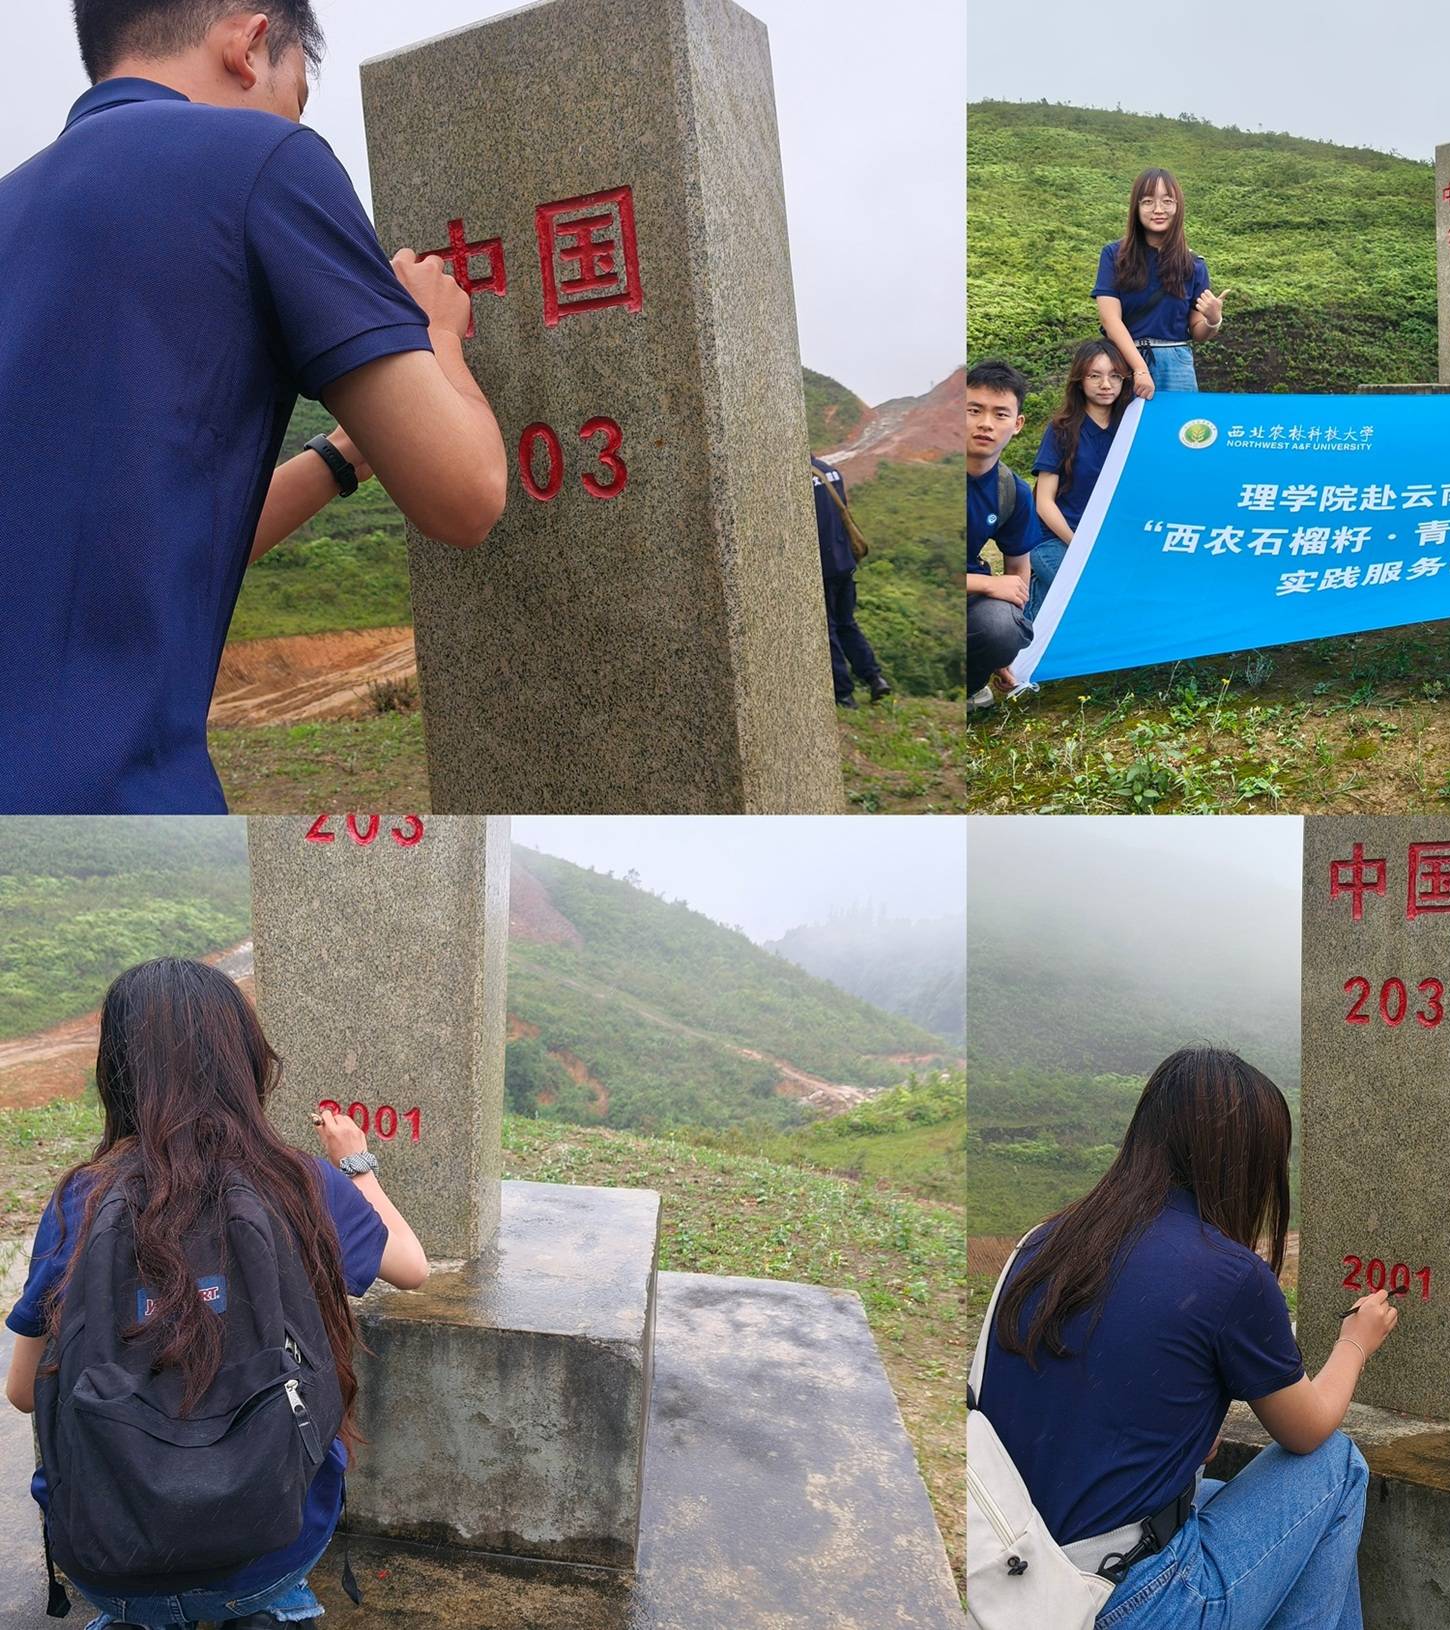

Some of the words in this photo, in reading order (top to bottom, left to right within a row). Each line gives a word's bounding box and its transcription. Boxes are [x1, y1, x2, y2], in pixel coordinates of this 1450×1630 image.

[413, 184, 644, 339] 中国
[518, 415, 629, 502] 03
[1226, 424, 1375, 443] 西北农林科技大学
[1226, 439, 1290, 450] NORTHWEST
[1291, 442, 1311, 451] A&F
[1313, 442, 1373, 452] UNIVERSITY
[1344, 976, 1445, 1029] 203
[1342, 1254, 1432, 1304] 2001
